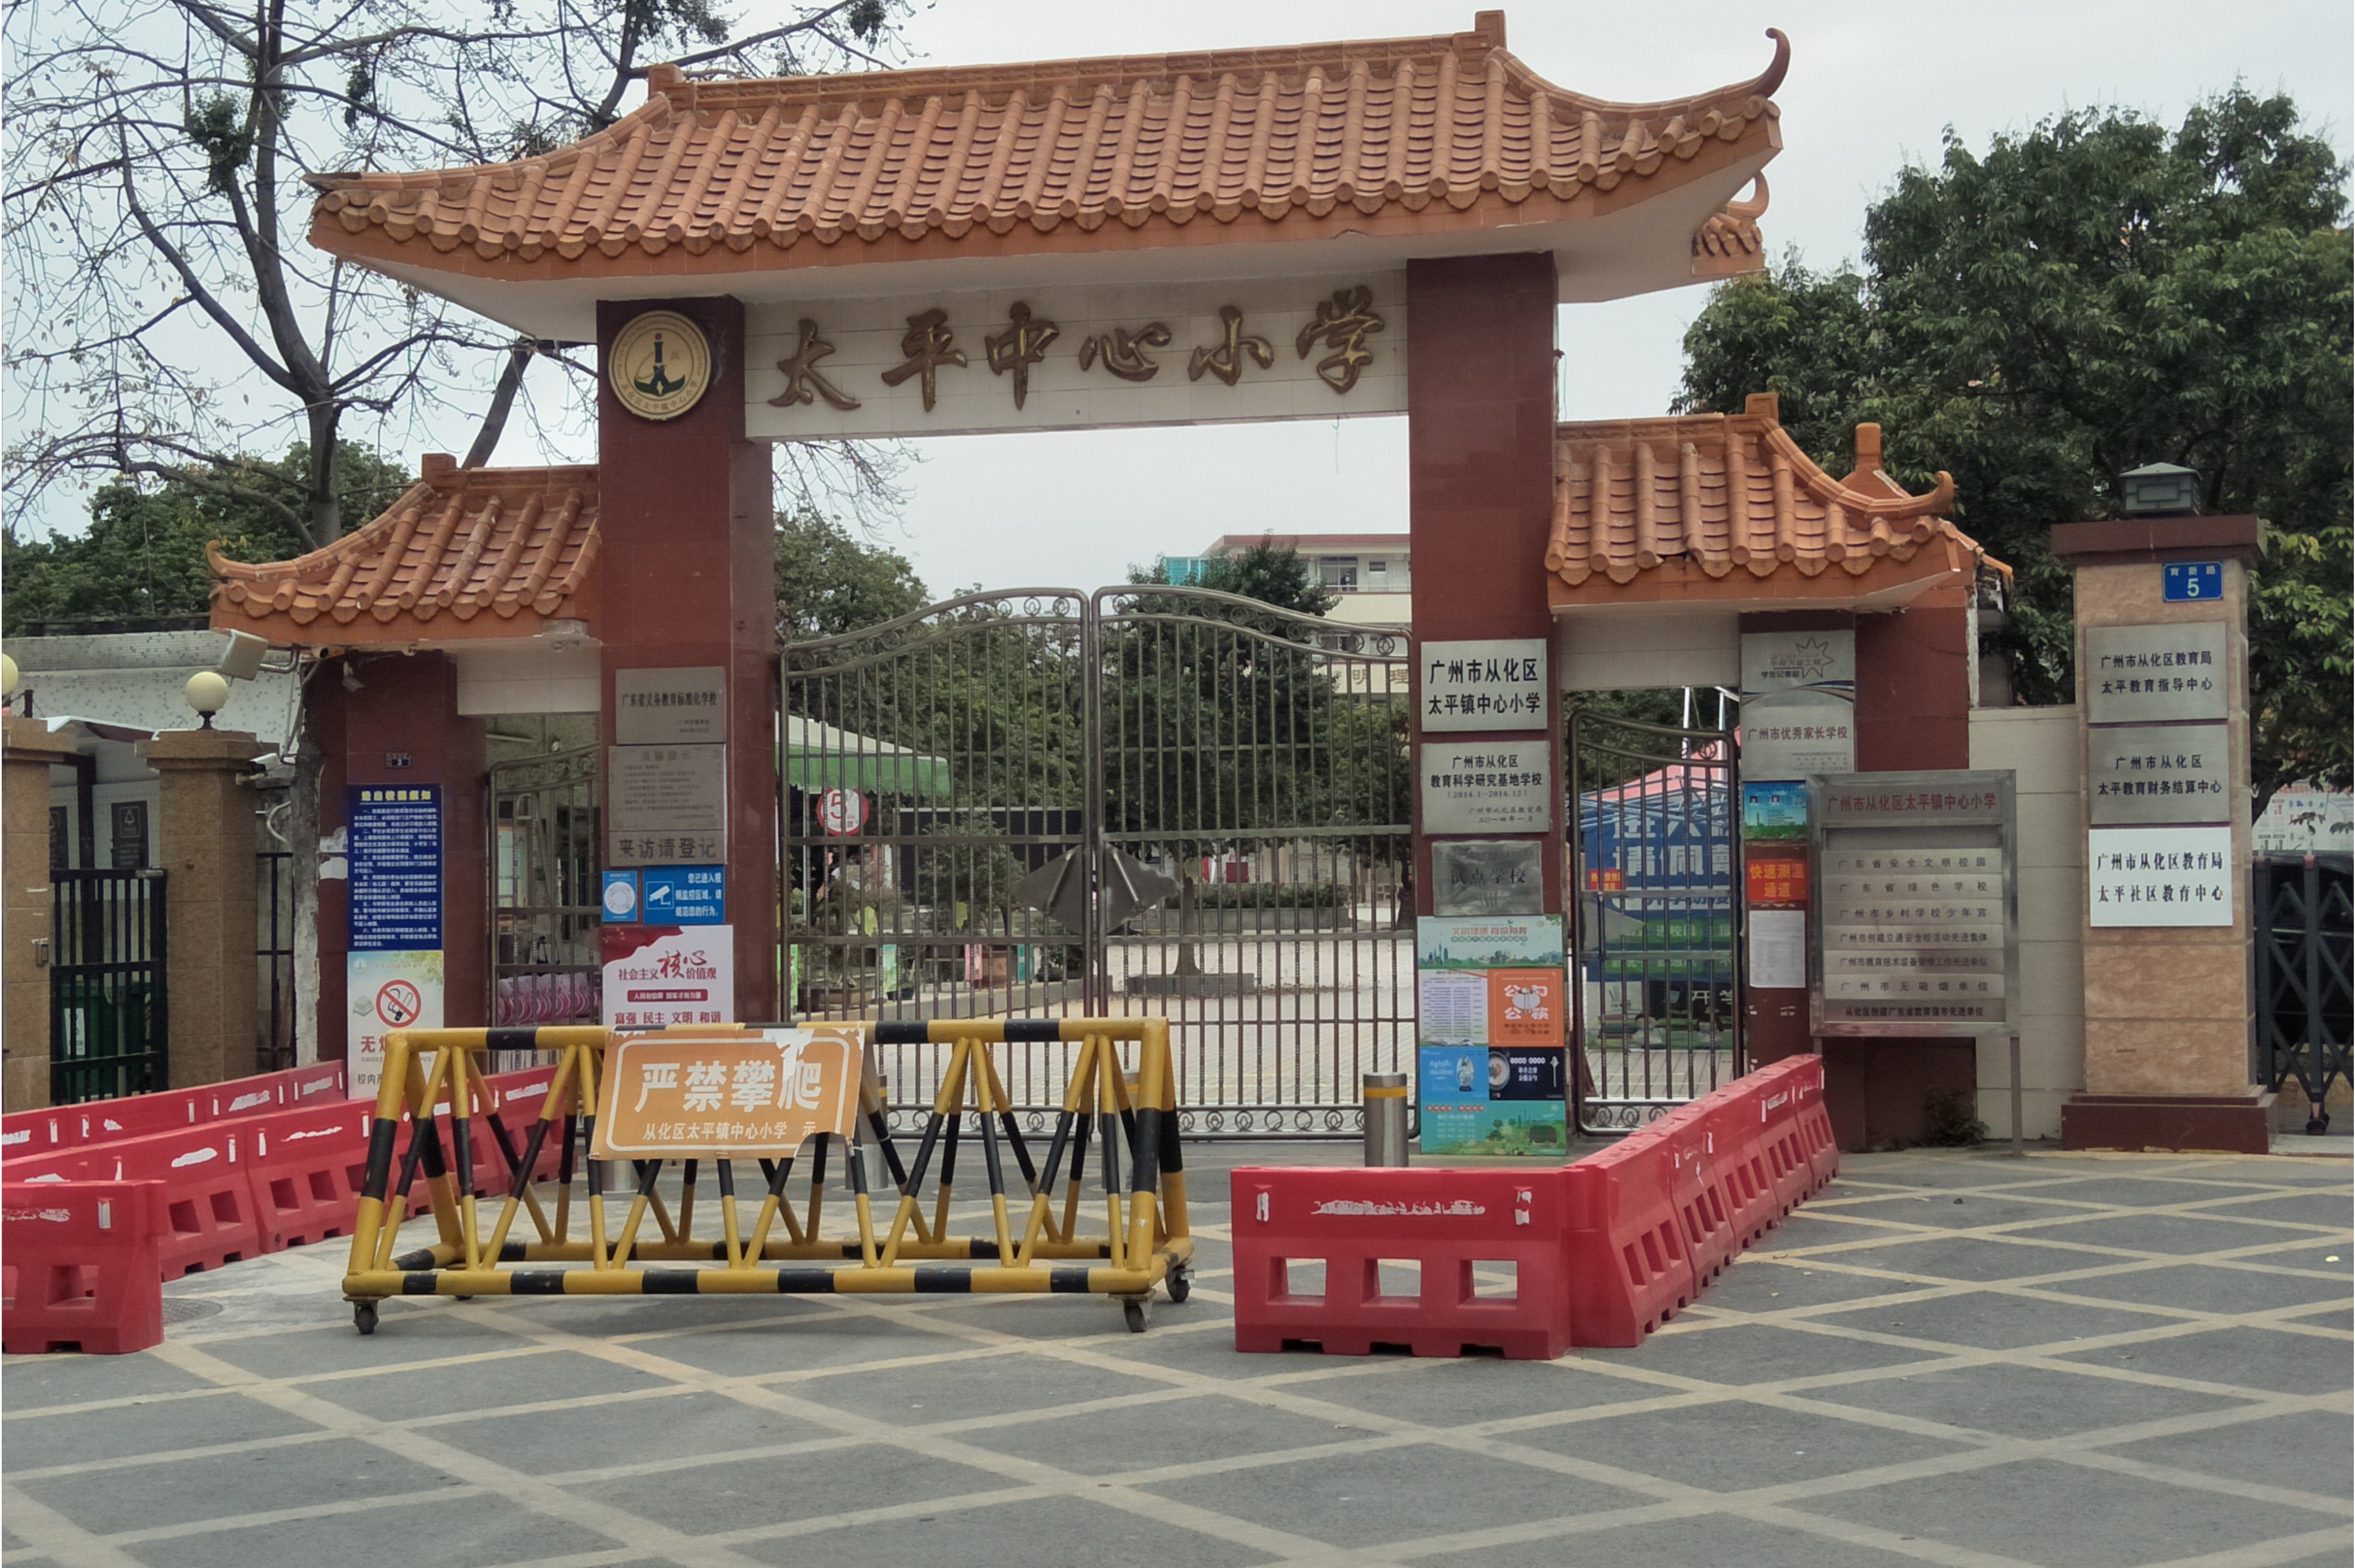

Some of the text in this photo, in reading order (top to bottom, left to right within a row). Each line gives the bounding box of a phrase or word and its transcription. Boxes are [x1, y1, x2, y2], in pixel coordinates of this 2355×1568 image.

[768, 284, 1383, 412] 太平中心小学
[2187, 578, 2200, 597] 5
[2101, 651, 2212, 669] 广州市从化区教育局
[1429, 658, 1538, 684] 广州市从化区
[2101, 677, 2213, 694] 太平教育指导中心
[622, 691, 717, 707] 广东省义务教育标准化学校
[1429, 691, 1540, 715] 太平镇中心小学
[1747, 727, 1848, 741] 广州市优秀家长学校
[1452, 754, 1519, 769] 广州市从化区
[2115, 754, 2203, 770] 广州市从化区
[1430, 773, 1542, 788] 教育科学研究基地学校
[2098, 780, 2222, 796] 太平教育财务结算中心
[1827, 792, 1997, 813] 广州市从化区太平镇中心小学
[619, 837, 716, 859] 来访请登记
[1838, 858, 1986, 869] 广东省安全文明校园
[2097, 852, 2223, 871] 广州市从化区教育局
[1451, 867, 1527, 885] 试点学校
[1750, 863, 1804, 879] 快速测温
[1764, 883, 1791, 898] 通道
[1839, 881, 1987, 893] 广东省绿色学校
[2098, 885, 2223, 903] 太平社区教育中心
[1840, 907, 1987, 918] 广州市乡村学校少年宫
[615, 1011, 722, 1024] 富强 民主 文明 和谐
[634, 1059, 822, 1113] 严禁攀爬
[643, 1121, 788, 1141] 从化区太平镇中心小学
